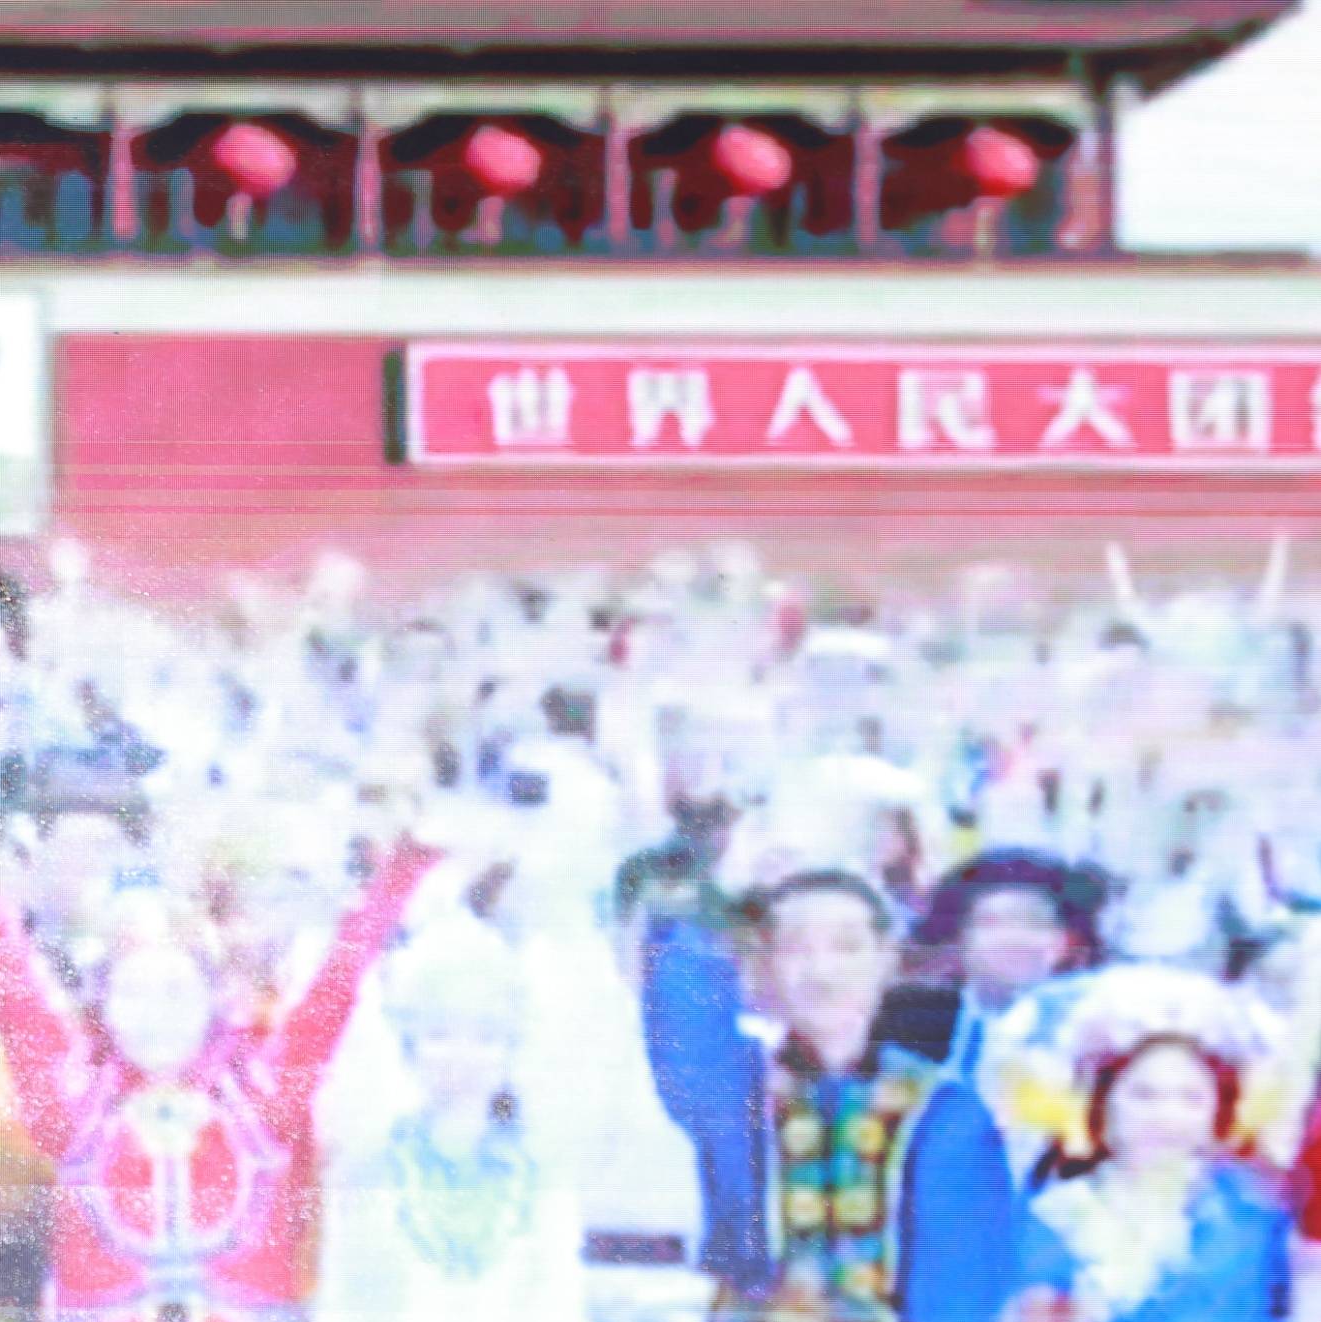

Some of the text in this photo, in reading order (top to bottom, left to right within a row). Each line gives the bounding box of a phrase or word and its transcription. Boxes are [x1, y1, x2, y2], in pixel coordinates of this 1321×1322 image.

[486, 364, 1321, 452] 世界人民大团
